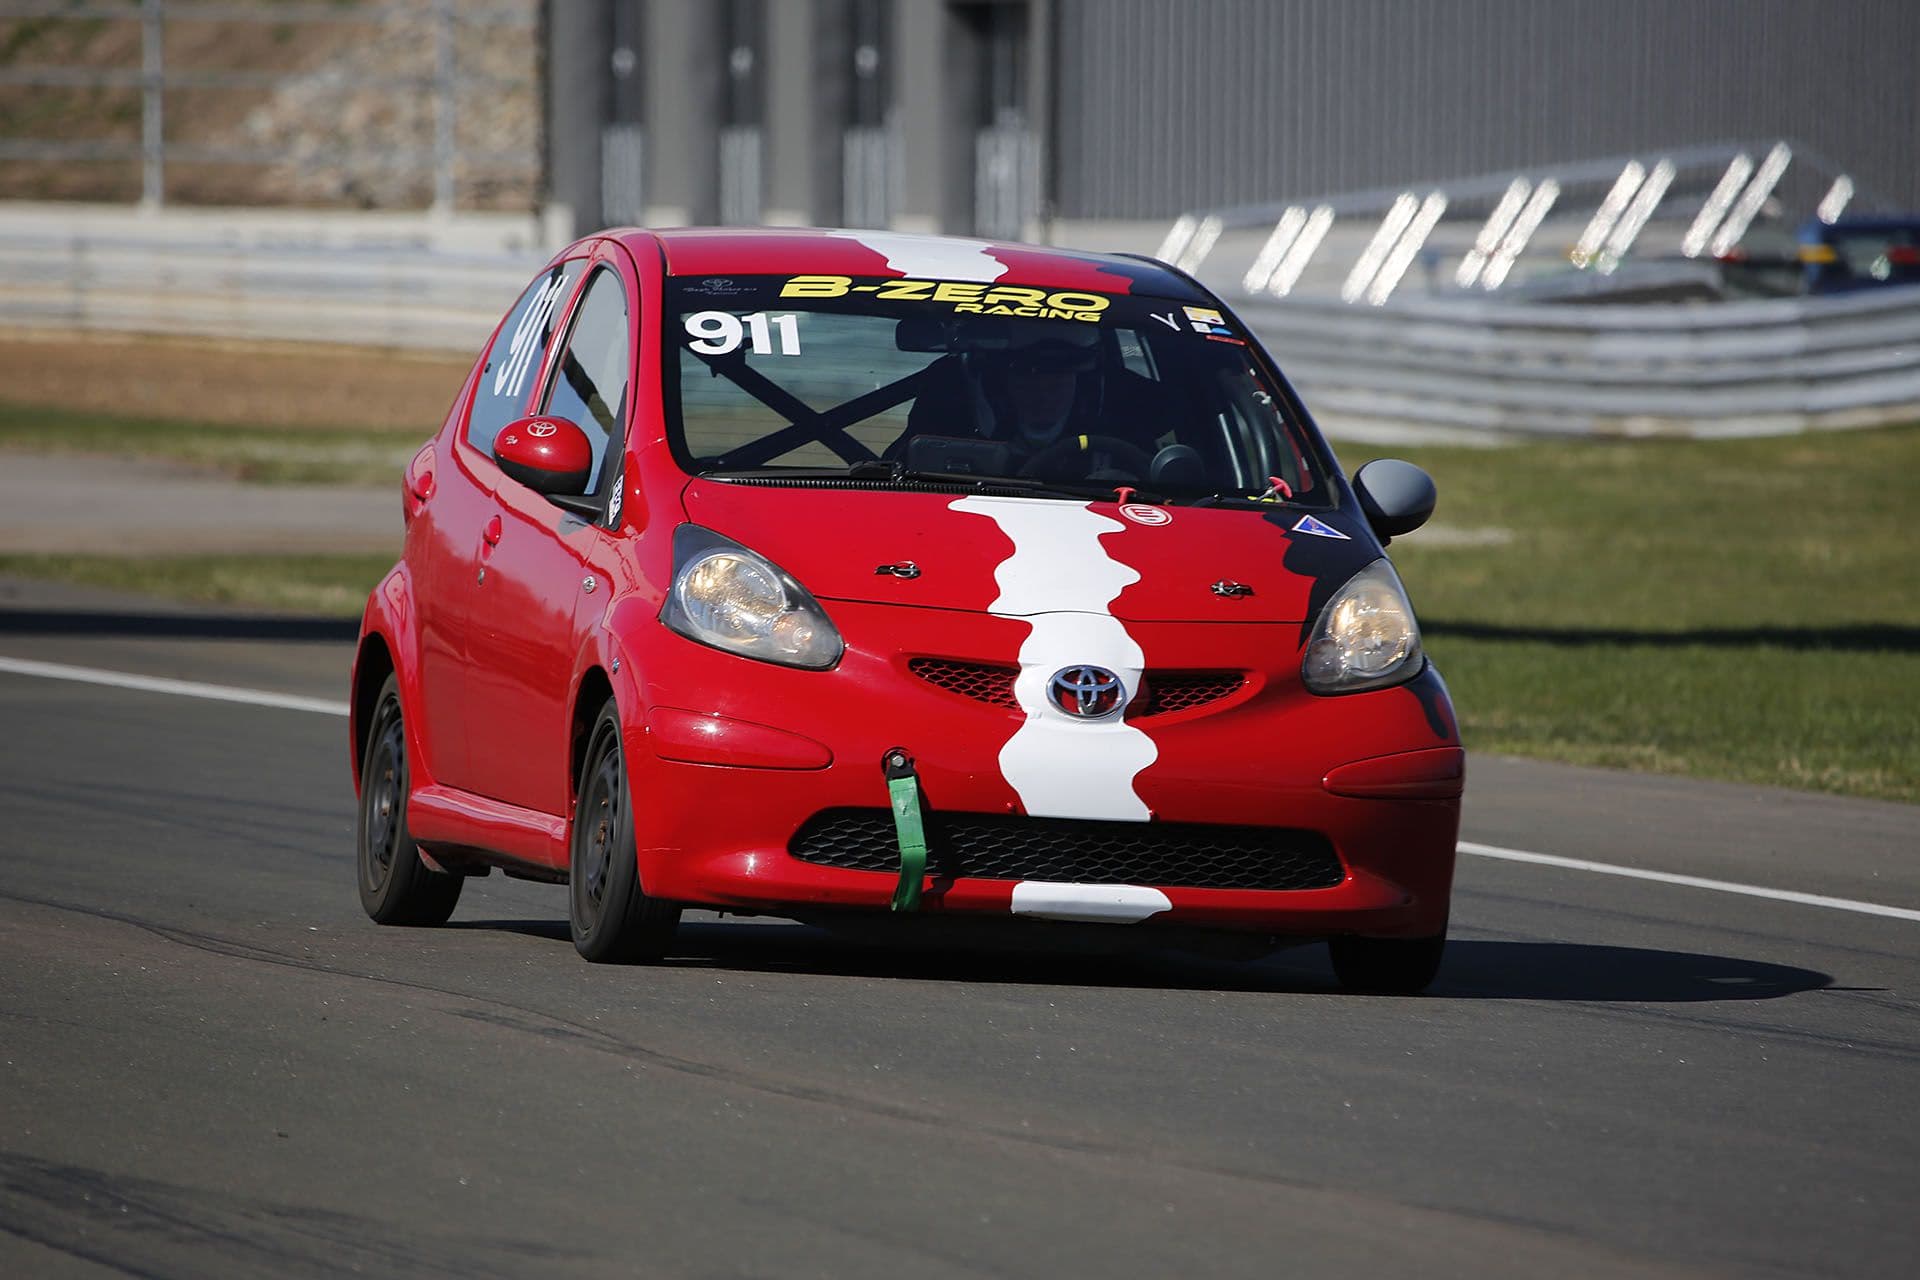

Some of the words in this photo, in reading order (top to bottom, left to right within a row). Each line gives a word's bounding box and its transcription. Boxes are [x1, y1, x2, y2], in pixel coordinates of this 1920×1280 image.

[779, 275, 1111, 312] B-ZERO
[954, 302, 1101, 323] RACING
[494, 275, 569, 396] 911
[684, 310, 801, 356] 911
